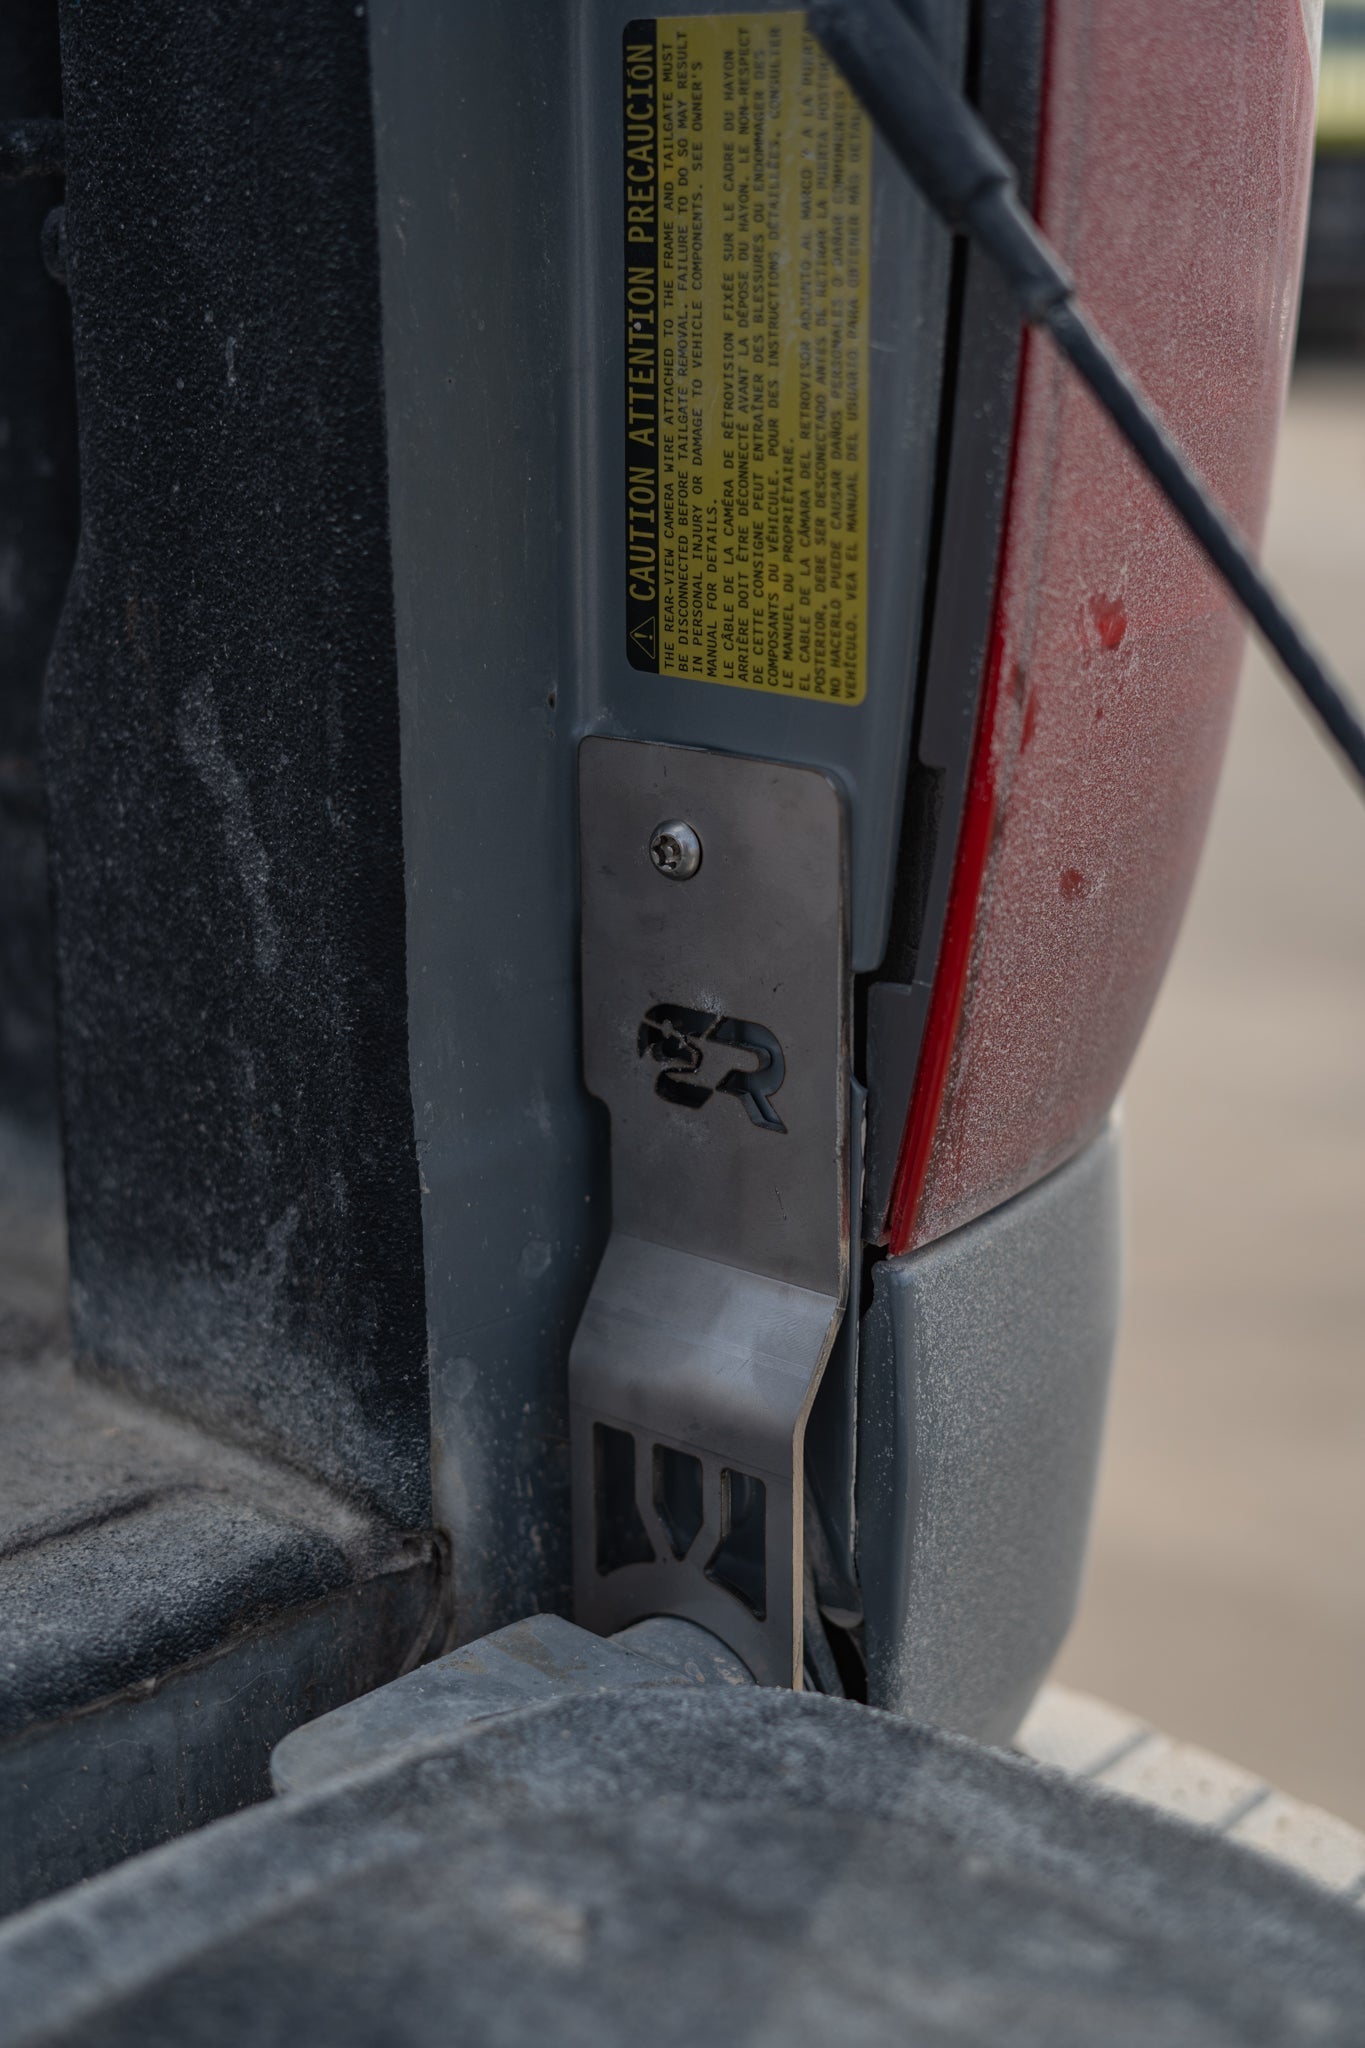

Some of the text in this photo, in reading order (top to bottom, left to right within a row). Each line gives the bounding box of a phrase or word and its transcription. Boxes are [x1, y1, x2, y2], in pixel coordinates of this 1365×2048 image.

[723, 50, 735, 101] HAYON
[816, 54, 829, 121] POSTER
[723, 111, 735, 131] DU
[800, 128, 813, 138] A
[847, 103, 860, 163] DETAL
[723, 143, 735, 192] CADRE
[723, 204, 735, 221] LE
[800, 168, 813, 220] MARCO
[815, 199, 829, 219] LA
[723, 232, 735, 262] SUR
[721, 273, 735, 321] FIXÉE
[768, 252, 780, 367] INSTRUCTIONS
[626, 44, 656, 601] CAUTION ATTENTION PRECAUCIÓN
[662, 44, 674, 668] THE REAR-VIEW CAMERA WIRE ATTACHED TO THE FRAME AND TAILGATE MUST
[676, 32, 688, 672] BE DISCONNECTED BEFORE TAILGATE REMOVAL. FAILURE TO DO SO MAY RESULT
[692, 62, 703, 673] IN PERSONAL INJURY OR DAMAGE TO VEHICLE COMPONENTS. SEE OWNER'S
[736, 28, 750, 682] ARRIÈRE DOIT ÊTRE DÉCONNECTÉ AVANT LA DÉPOSE DU HAYON. LE NON-RESPECT
[751, 50, 765, 685] DE CETTE CONSIGNE PEUT ENTRAÎNER DES BLESSURES OU ENDOMMAGER DES
[721, 332, 735, 440] RÉTROVISION
[768, 380, 780, 409] DES
[800, 340, 812, 440] RETROVISOR
[846, 349, 859, 421] USUARIO
[768, 418, 780, 457] POUR
[815, 393, 828, 509] DESCONECTADO
[829, 410, 843, 460] DAÑOS
[846, 433, 859, 462] DEL
[724, 451, 735, 469] DE
[800, 452, 812, 480] DEL
[766, 470, 780, 553] VÉHICULE.
[831, 470, 843, 530] CAUSAR
[846, 474, 859, 533] MANUAL
[724, 546, 734, 565] LA
[815, 517, 827, 546] SER
[846, 543, 858, 562] EL
[707, 499, 718, 677] MANUAL FOR DETAILS.
[724, 576, 734, 594] DE
[769, 563, 780, 583] DU
[781, 439, 795, 689] LE MANUEL DU PROPRIÉTAIRE.
[800, 557, 811, 577] LA
[815, 556, 827, 593] DEBE
[831, 541, 843, 590] PUEDE
[846, 572, 858, 601] VEA
[800, 587, 811, 606] DE
[722, 604, 734, 651] CÂBLE
[769, 592, 780, 687] COMPOSANTS
[800, 616, 811, 664] CABLE
[831, 598, 842, 668] HACERLO
[724, 661, 734, 679] LE
[844, 615, 858, 699] VEHÍCULO.
[800, 674, 811, 692] EL
[831, 677, 842, 697] NO
